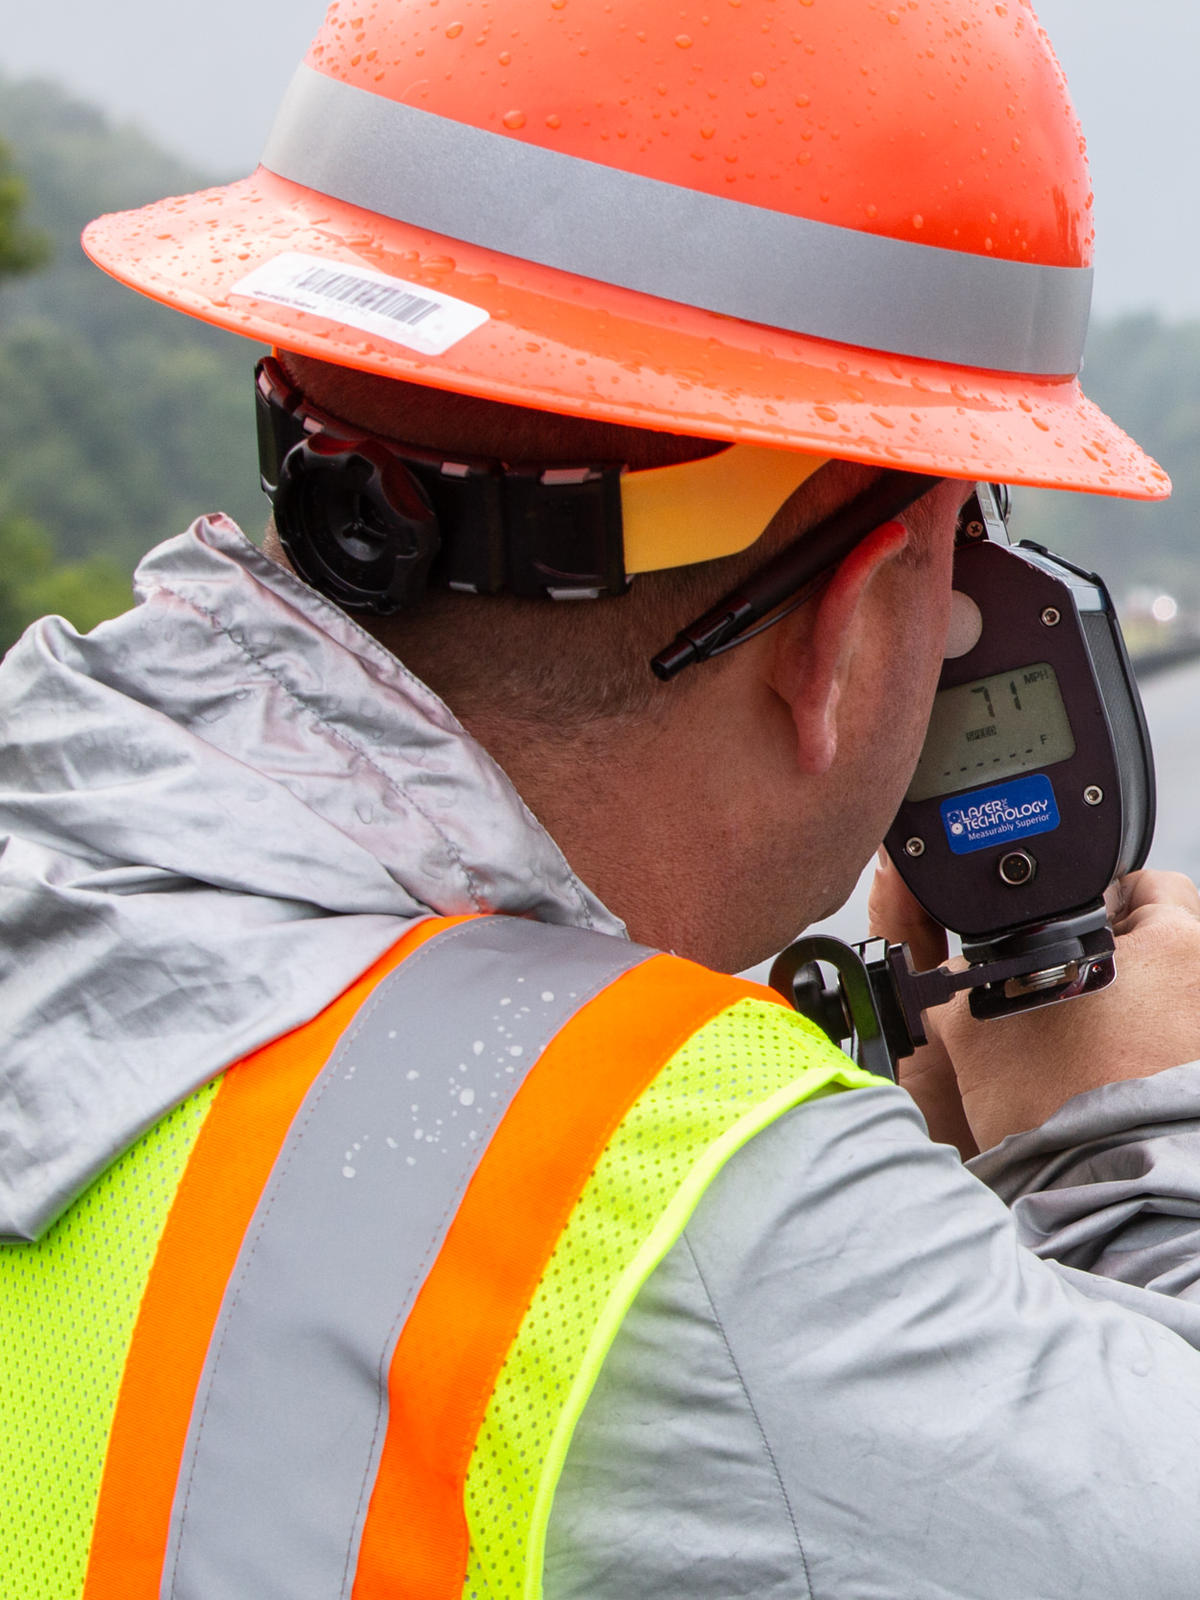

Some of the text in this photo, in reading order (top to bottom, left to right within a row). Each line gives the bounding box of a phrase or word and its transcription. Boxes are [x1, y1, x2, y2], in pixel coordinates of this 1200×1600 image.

[1024, 670, 1049, 685] MPH
[971, 680, 1022, 718] 71
[960, 800, 1002, 821] LASER
[963, 799, 1048, 831] TECHNOLOGY
[968, 814, 1050, 841] Measurably Superior
